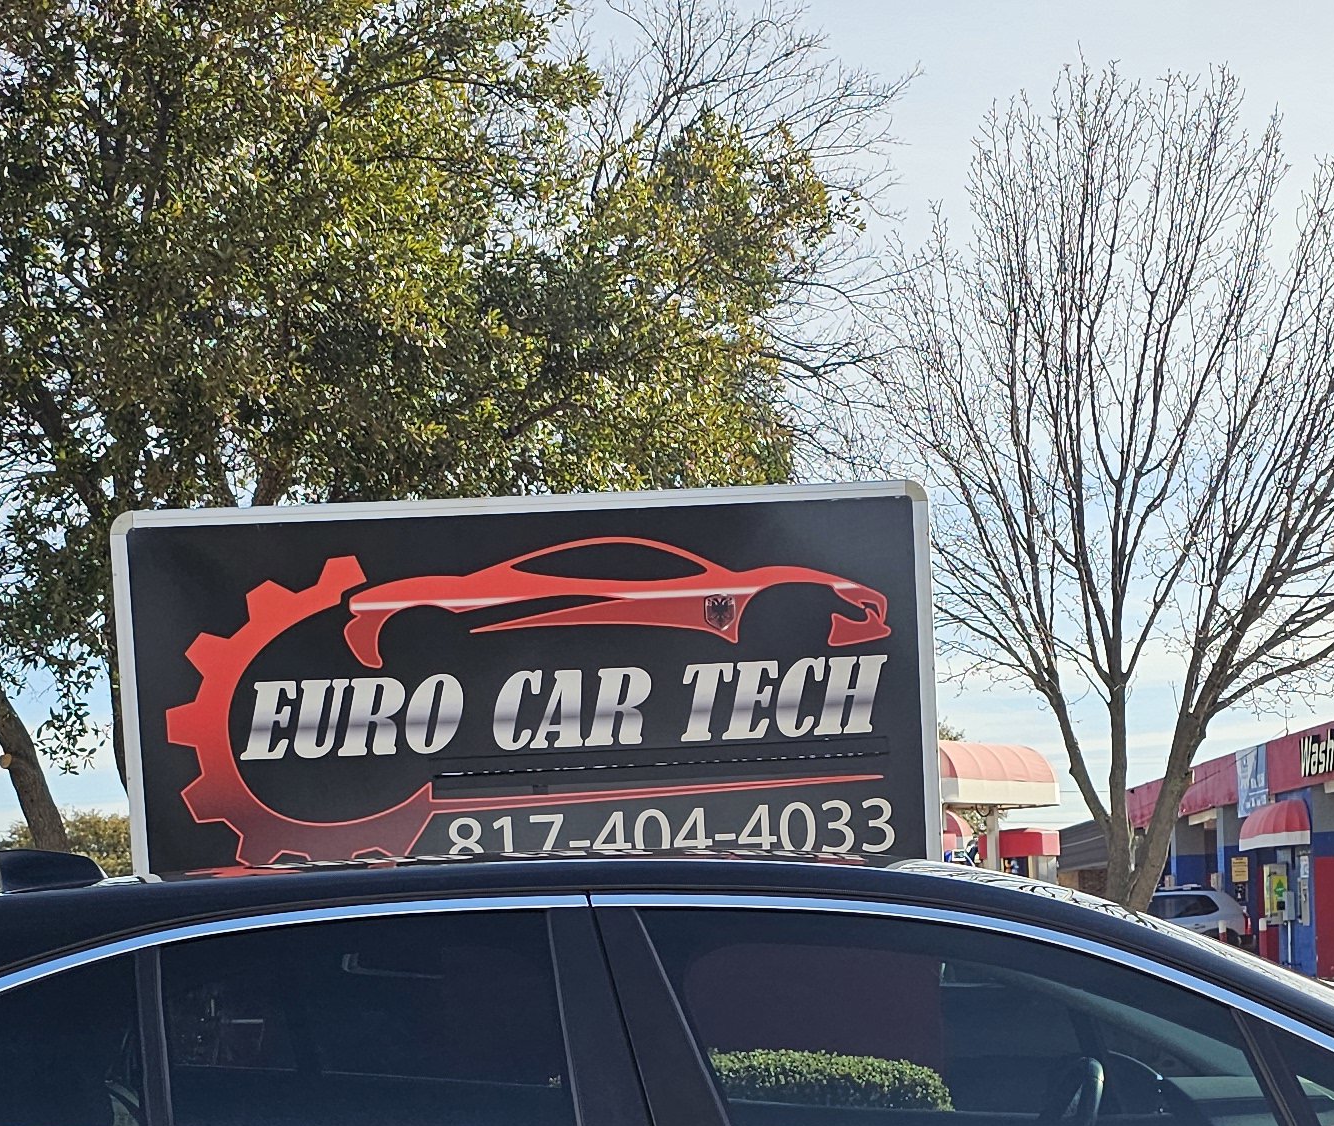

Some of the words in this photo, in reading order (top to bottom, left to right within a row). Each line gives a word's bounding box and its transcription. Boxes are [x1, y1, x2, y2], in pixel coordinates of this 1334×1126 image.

[240, 673, 465, 761] EURO
[493, 666, 654, 751] CAR
[680, 655, 889, 743] TECH
[446, 797, 897, 856] 817-404-4033
